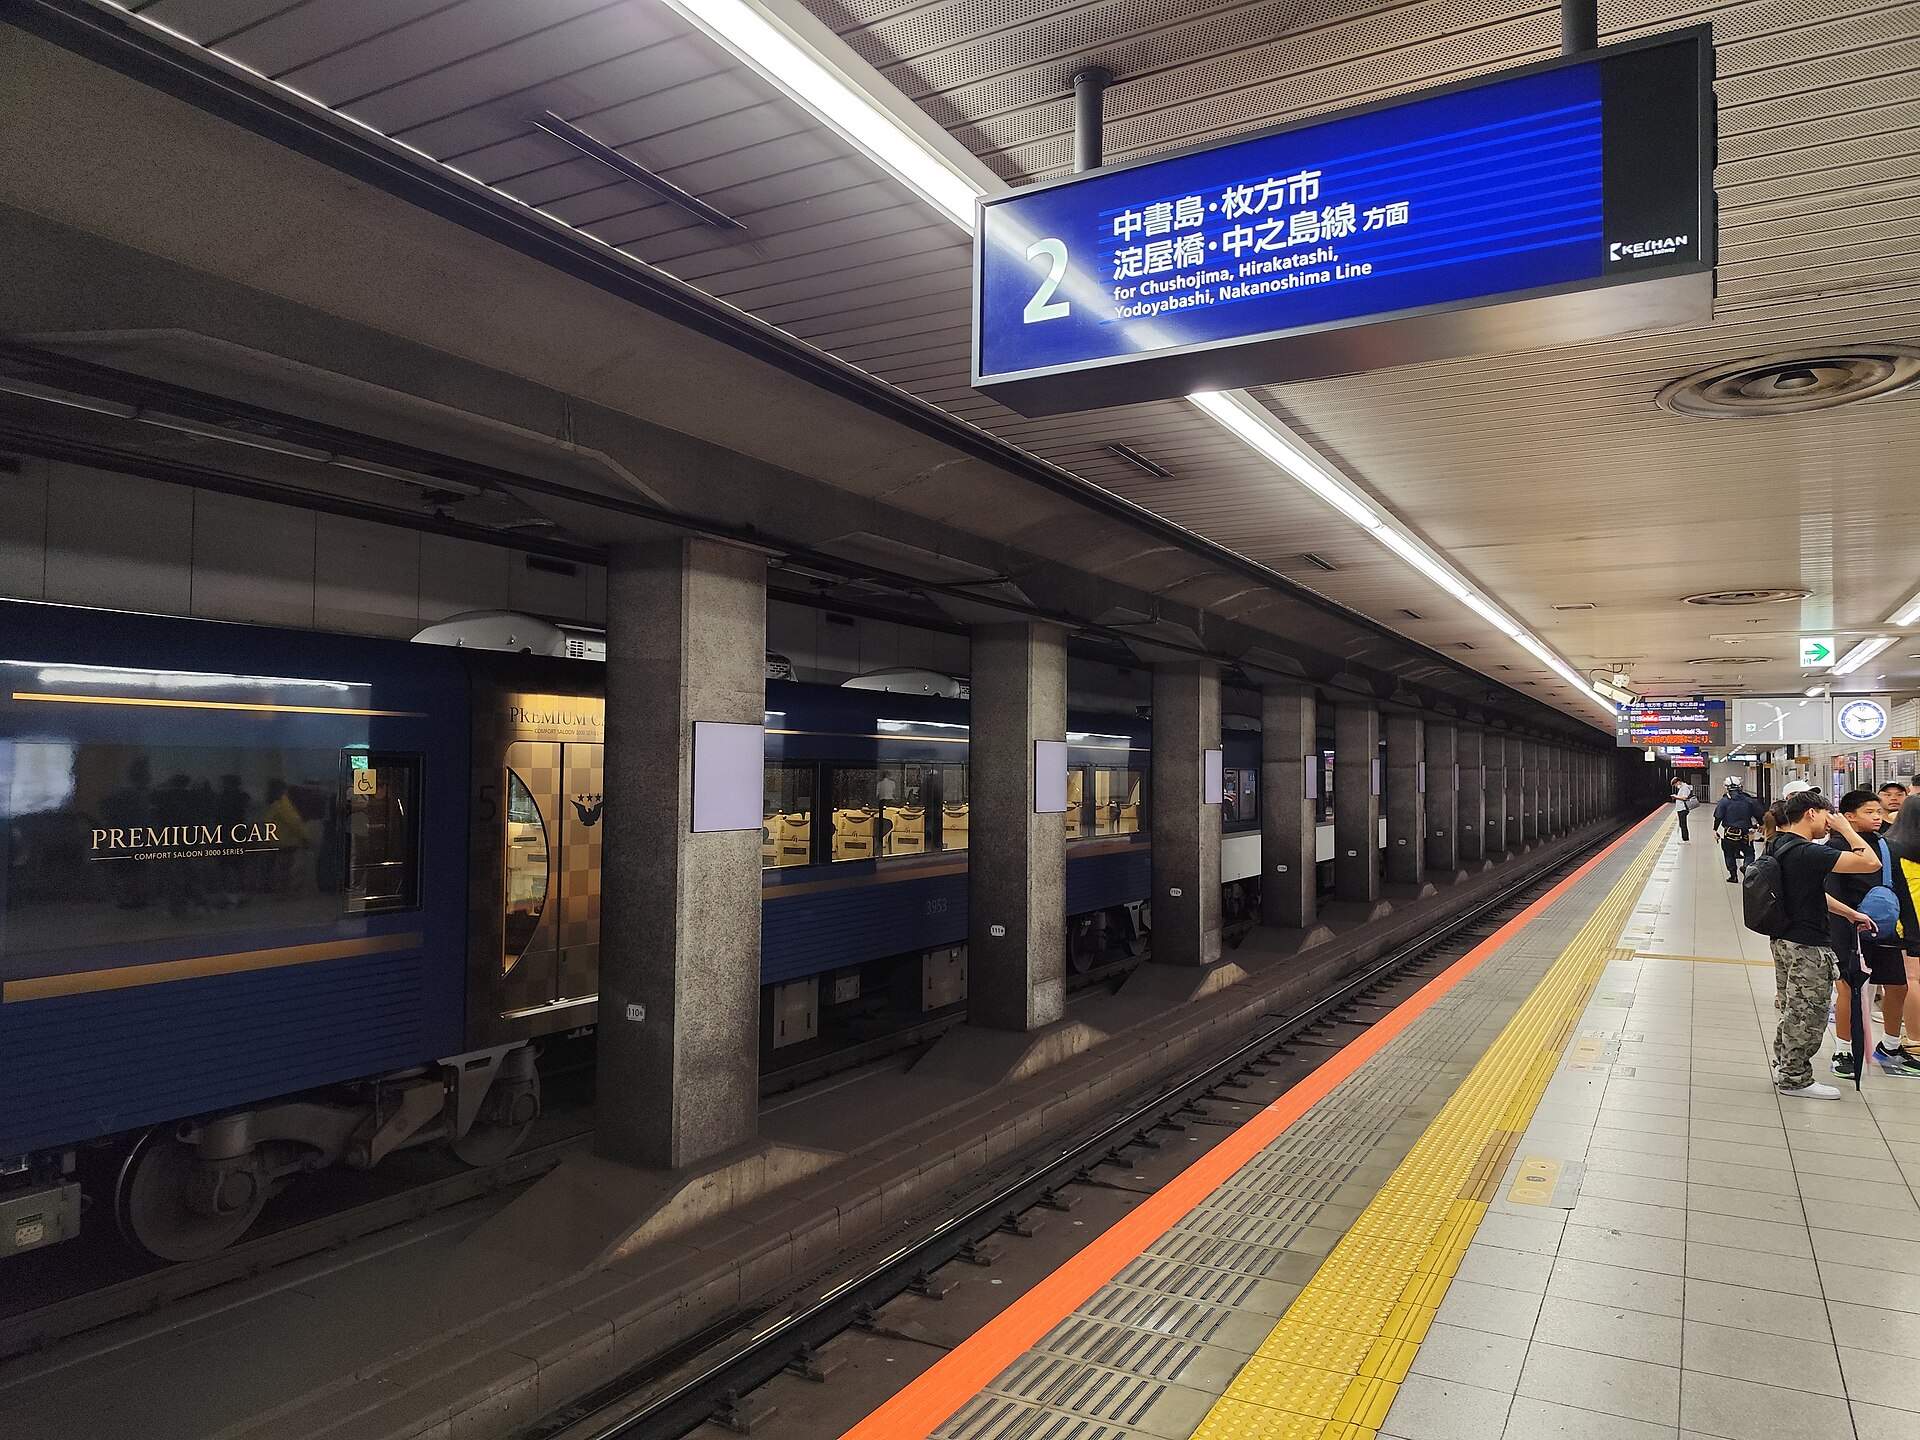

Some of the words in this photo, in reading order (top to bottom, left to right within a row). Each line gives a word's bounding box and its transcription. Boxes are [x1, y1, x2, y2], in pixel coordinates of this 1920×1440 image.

[1113, 169, 1322, 242] 中書島・枚方市
[1112, 202, 1357, 281] 淀屋橋・中之島線
[1362, 201, 1410, 232] 方面
[1622, 235, 1688, 254] KEIHAN
[1023, 237, 1070, 324] 2
[1114, 286, 1136, 301] for
[1140, 267, 1235, 297] Chushojima,
[1239, 246, 1339, 277] Hirakatashi,
[1114, 289, 1214, 319] Yodoyabashi,
[1219, 270, 1329, 301] Nakanoshima
[1335, 262, 1373, 279] Line
[509, 706, 586, 726] PREMIUM
[591, 711, 605, 726] C
[91, 824, 223, 850] PREMIUM
[230, 822, 280, 843] CAR
[134, 851, 171, 861] COMFORT
[173, 849, 203, 859] SALOON
[204, 848, 221, 857] 3000
[222, 847, 244, 856] SERIES
[926, 898, 947, 915] 3953
